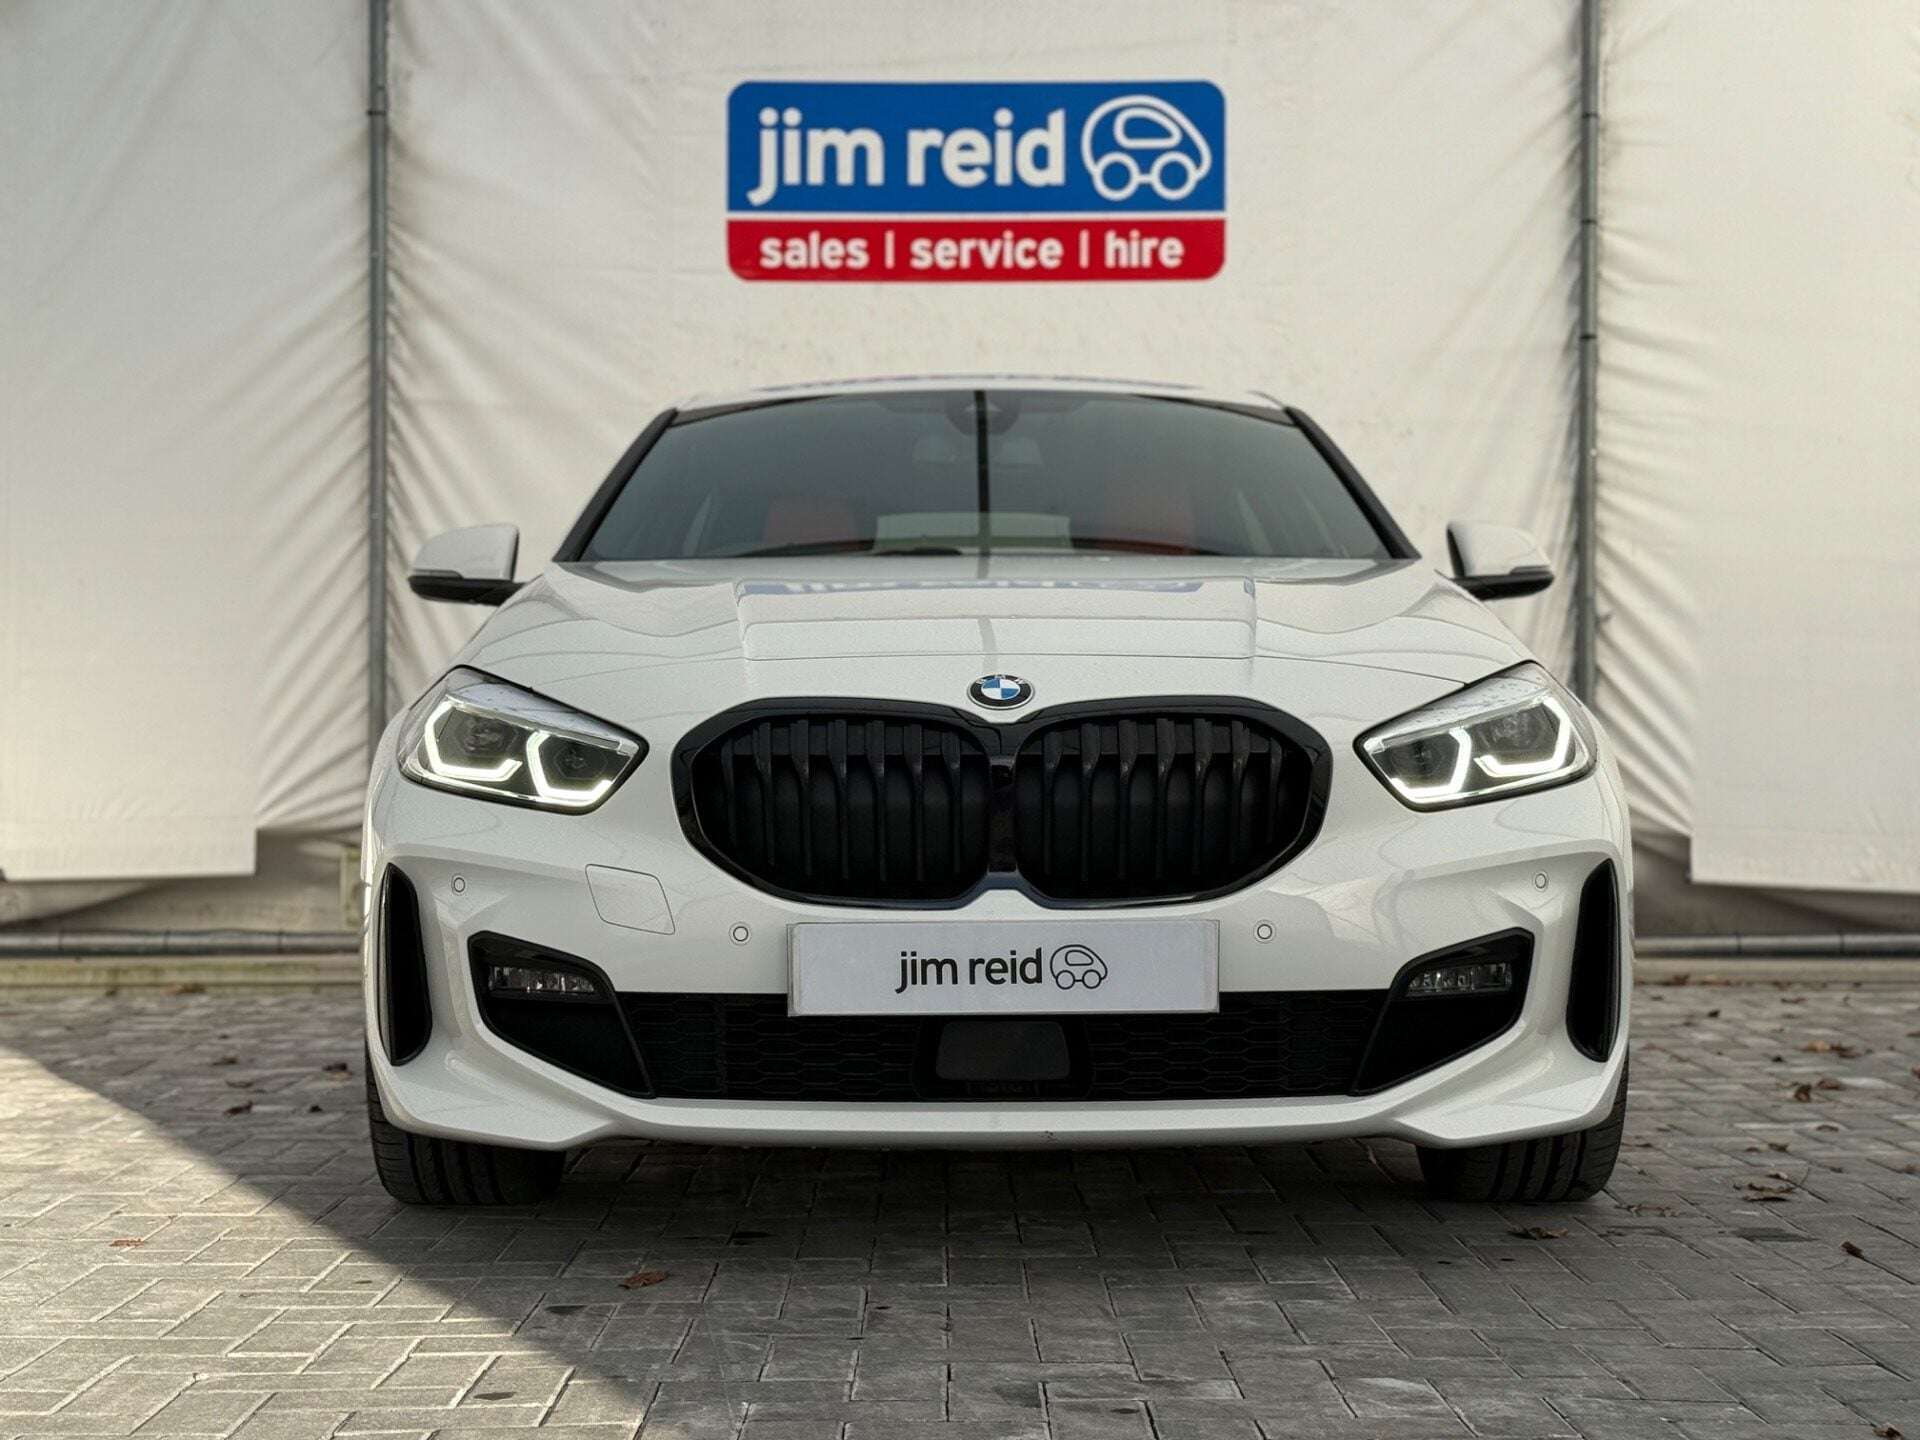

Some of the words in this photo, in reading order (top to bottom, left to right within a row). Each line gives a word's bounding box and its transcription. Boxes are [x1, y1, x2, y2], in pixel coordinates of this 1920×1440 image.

[747, 107, 885, 206] jim
[907, 108, 1066, 187] reid
[760, 231, 870, 269] sales
[910, 230, 1064, 269] service
[1105, 229, 1185, 268] hire
[895, 951, 958, 994] jim
[969, 947, 1042, 985] reid
